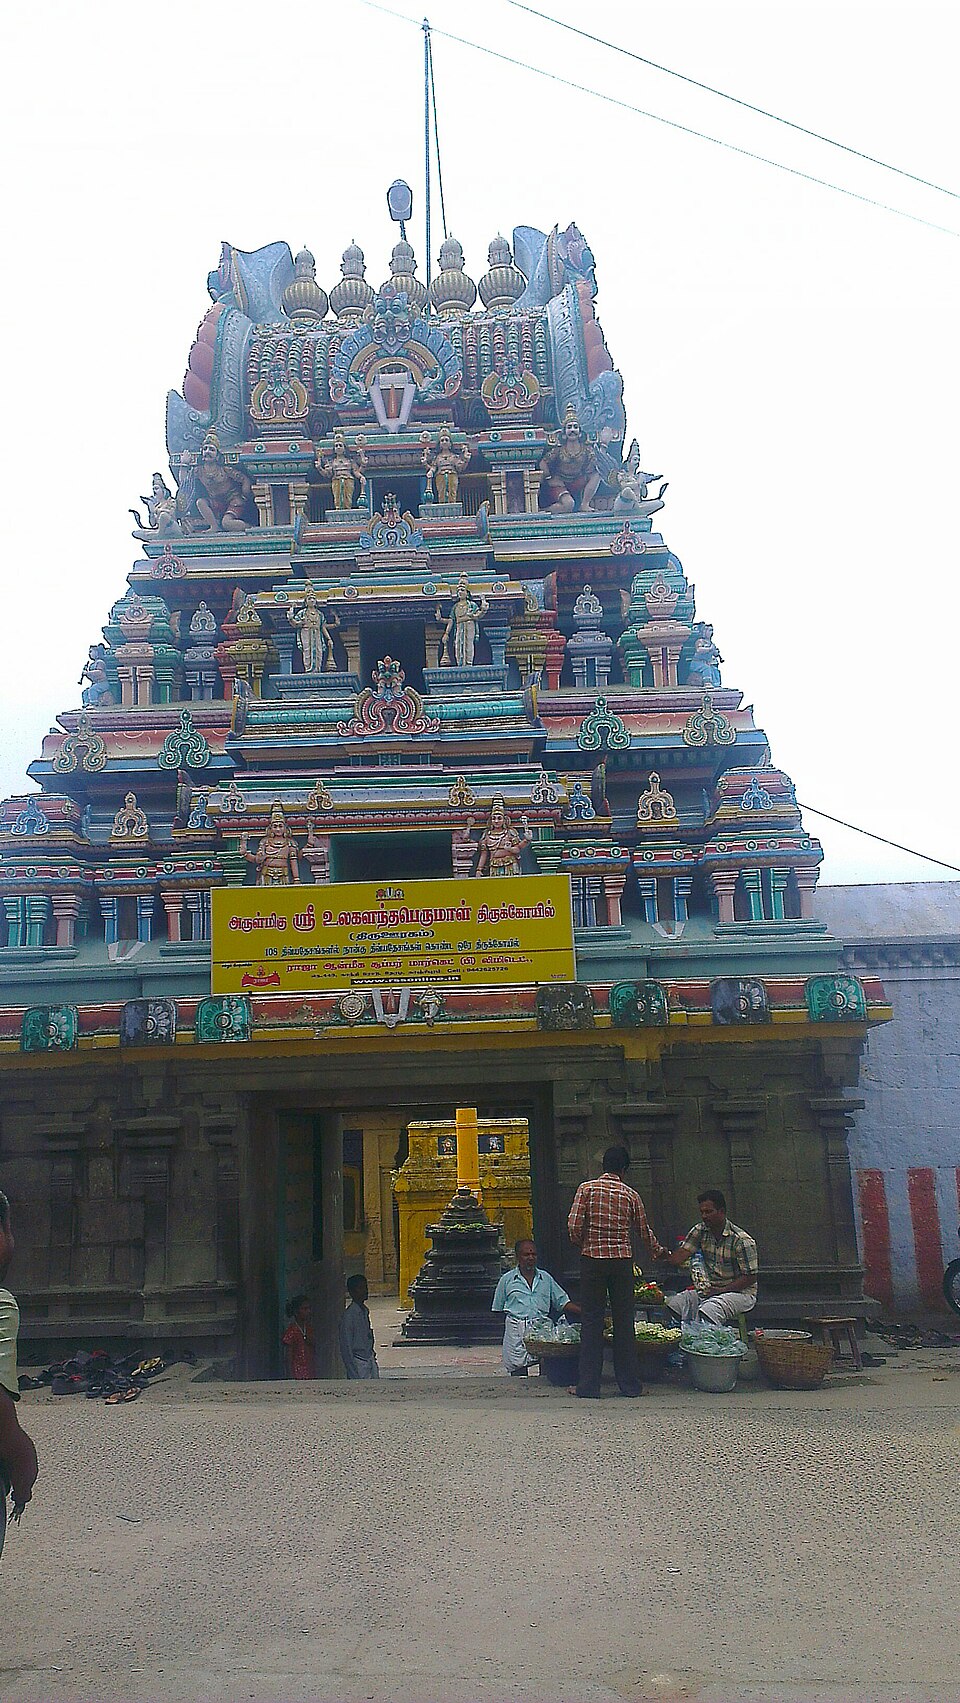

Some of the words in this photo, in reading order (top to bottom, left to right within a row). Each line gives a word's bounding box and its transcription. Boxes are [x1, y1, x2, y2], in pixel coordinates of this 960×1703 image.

[228, 912, 287, 933] அருள்மிகு
[292, 904, 316, 932] ஸ்ரீ
[322, 899, 472, 930] உலகளந்தபெருமாள்
[476, 899, 556, 924] திருக்கோயில்
[264, 948, 278, 957] 108
